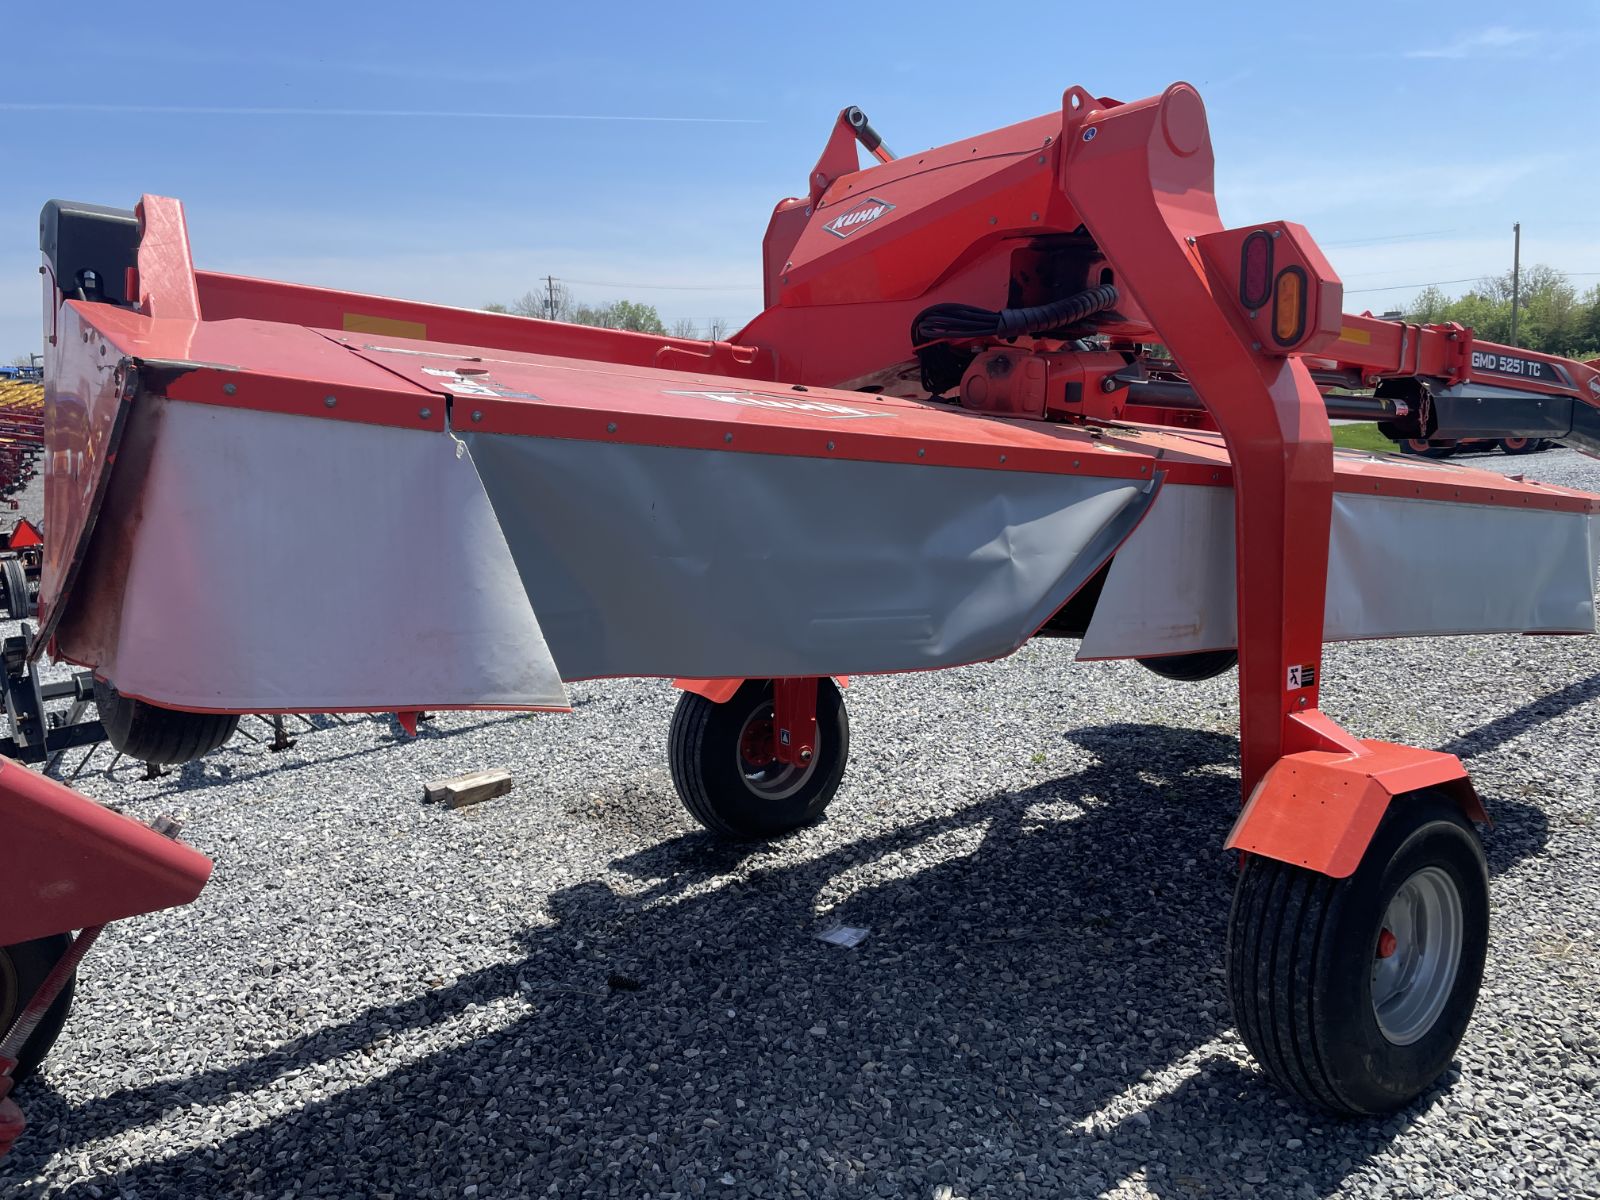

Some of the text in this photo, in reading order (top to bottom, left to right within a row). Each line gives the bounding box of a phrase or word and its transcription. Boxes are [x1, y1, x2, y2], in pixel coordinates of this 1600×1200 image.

[831, 204, 886, 230] KUHN
[1471, 352, 1541, 377] GMD 5251 TC
